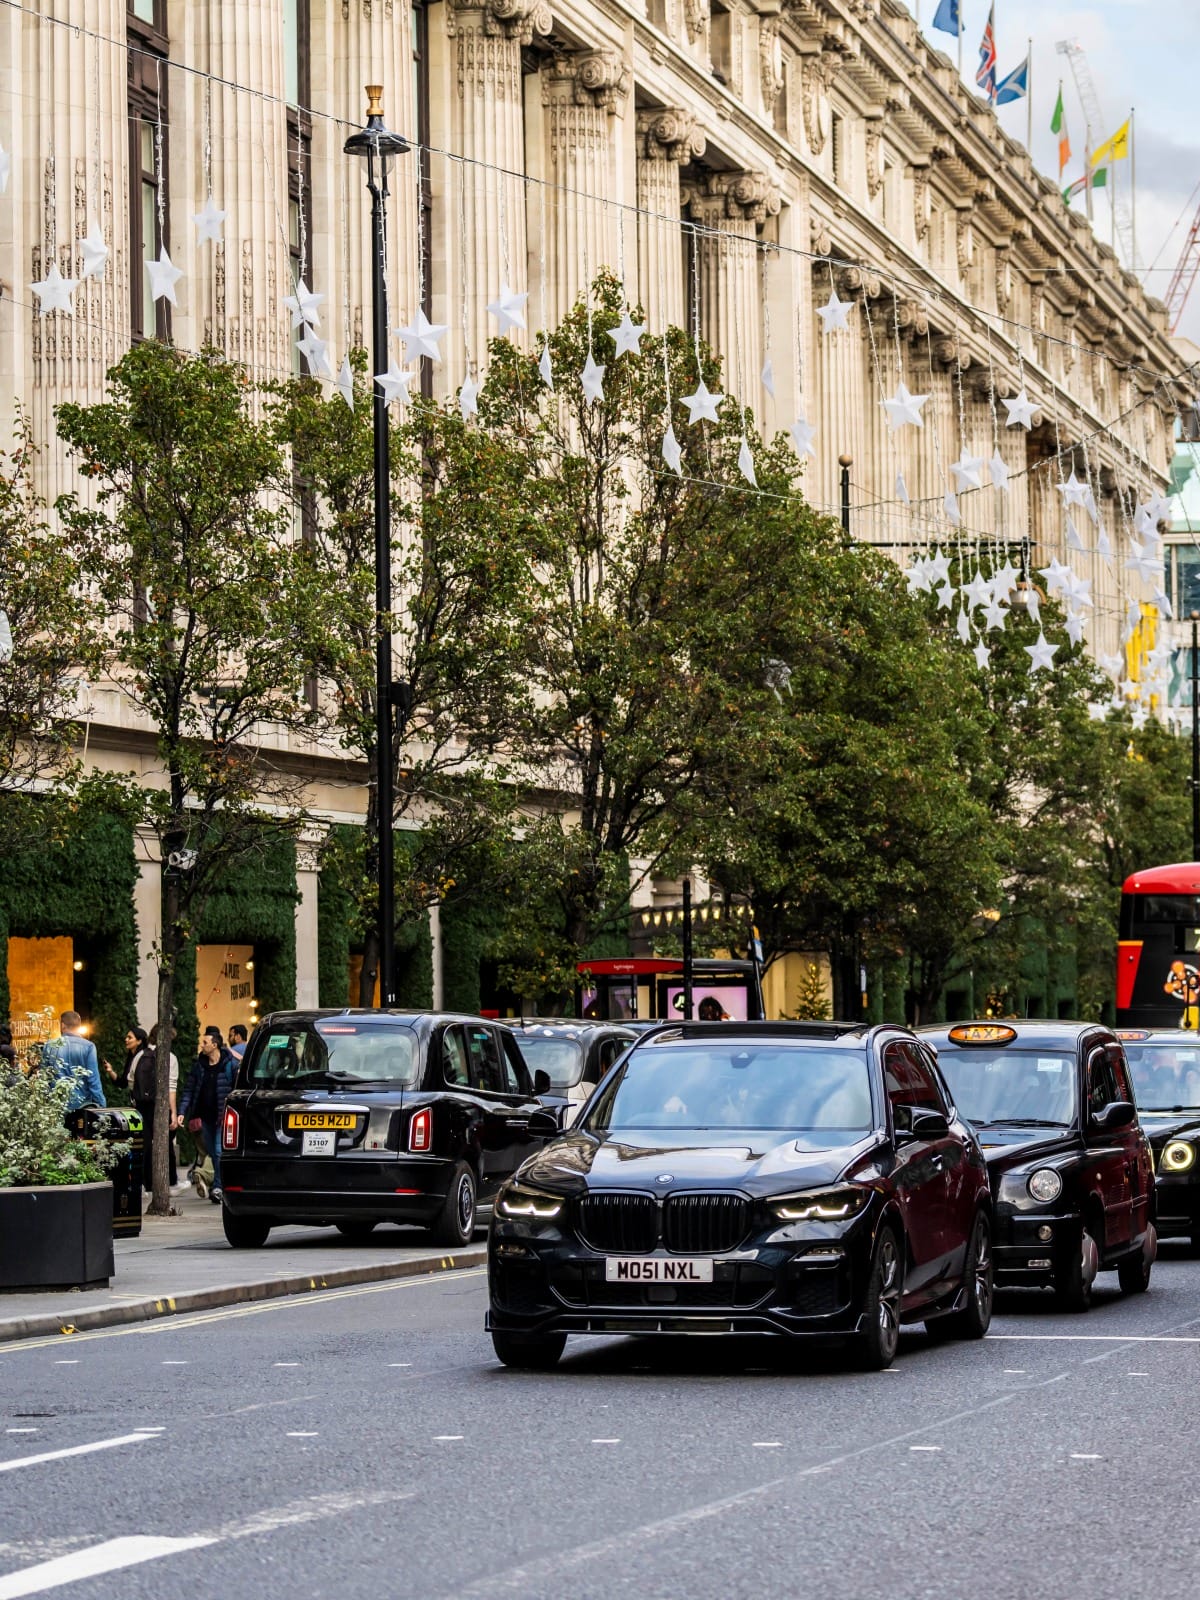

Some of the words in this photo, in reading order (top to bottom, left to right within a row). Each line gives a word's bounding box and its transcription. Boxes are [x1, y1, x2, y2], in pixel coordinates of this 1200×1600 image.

[964, 1028, 1001, 1040] TAXI
[294, 1114, 325, 1126] LO69
[328, 1114, 351, 1126] MZD
[618, 1261, 659, 1279] MO51
[664, 1261, 701, 1280] NXL
